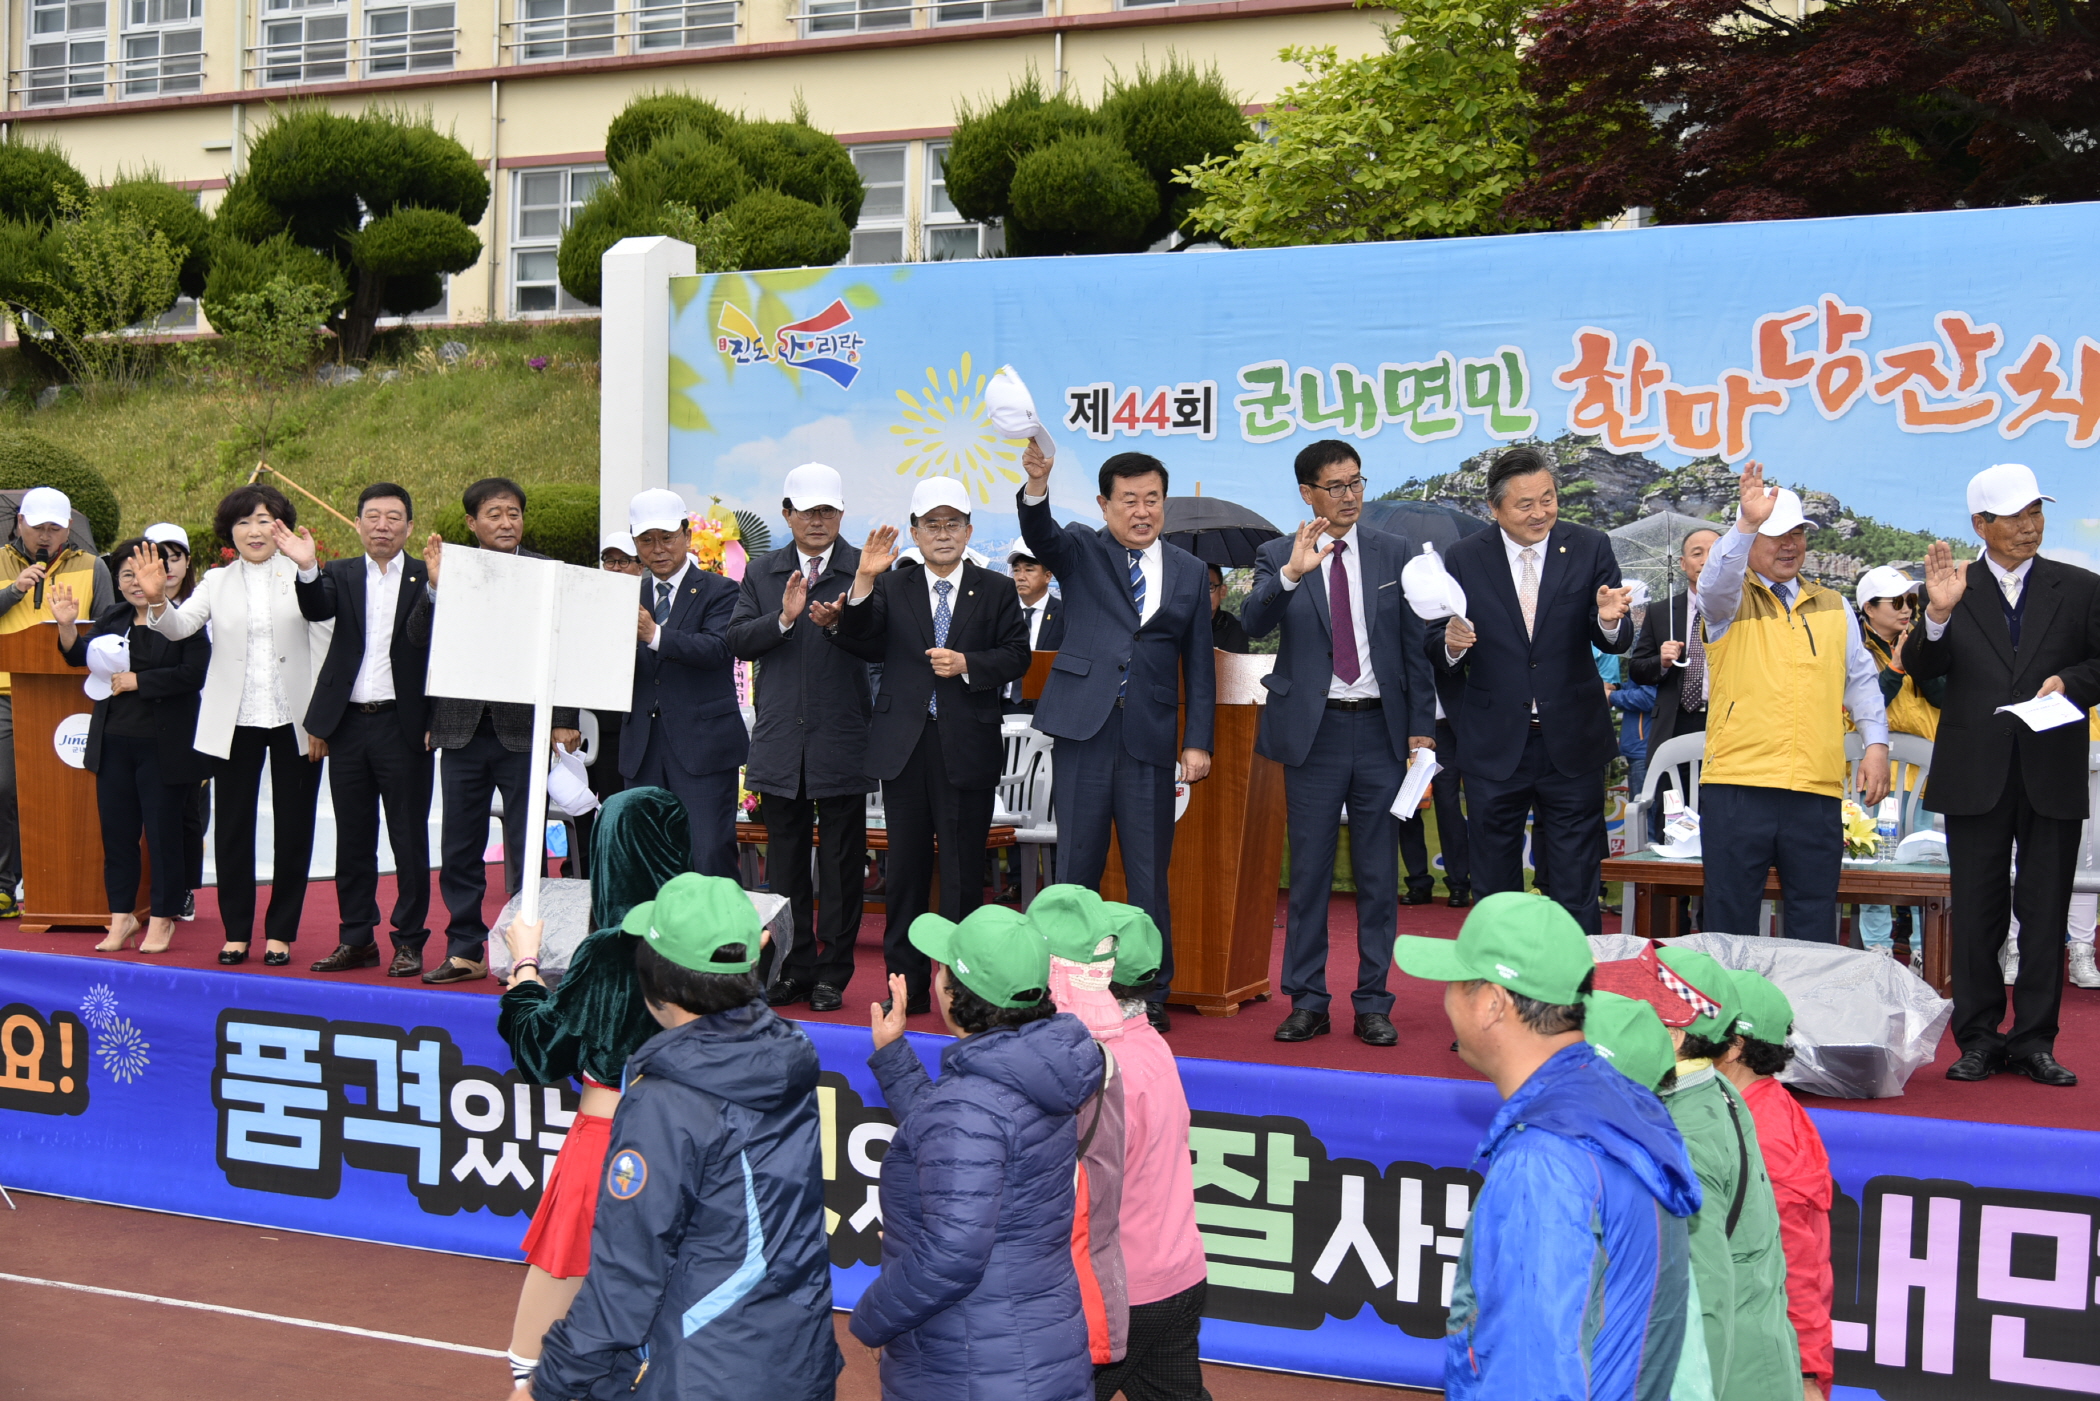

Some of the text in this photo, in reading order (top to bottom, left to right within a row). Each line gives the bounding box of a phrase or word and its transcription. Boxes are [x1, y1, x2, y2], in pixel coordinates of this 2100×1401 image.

[1070, 386, 1212, 434] 제44회
[1240, 351, 1532, 436] 군내면민
[0, 1013, 75, 1094] 요!
